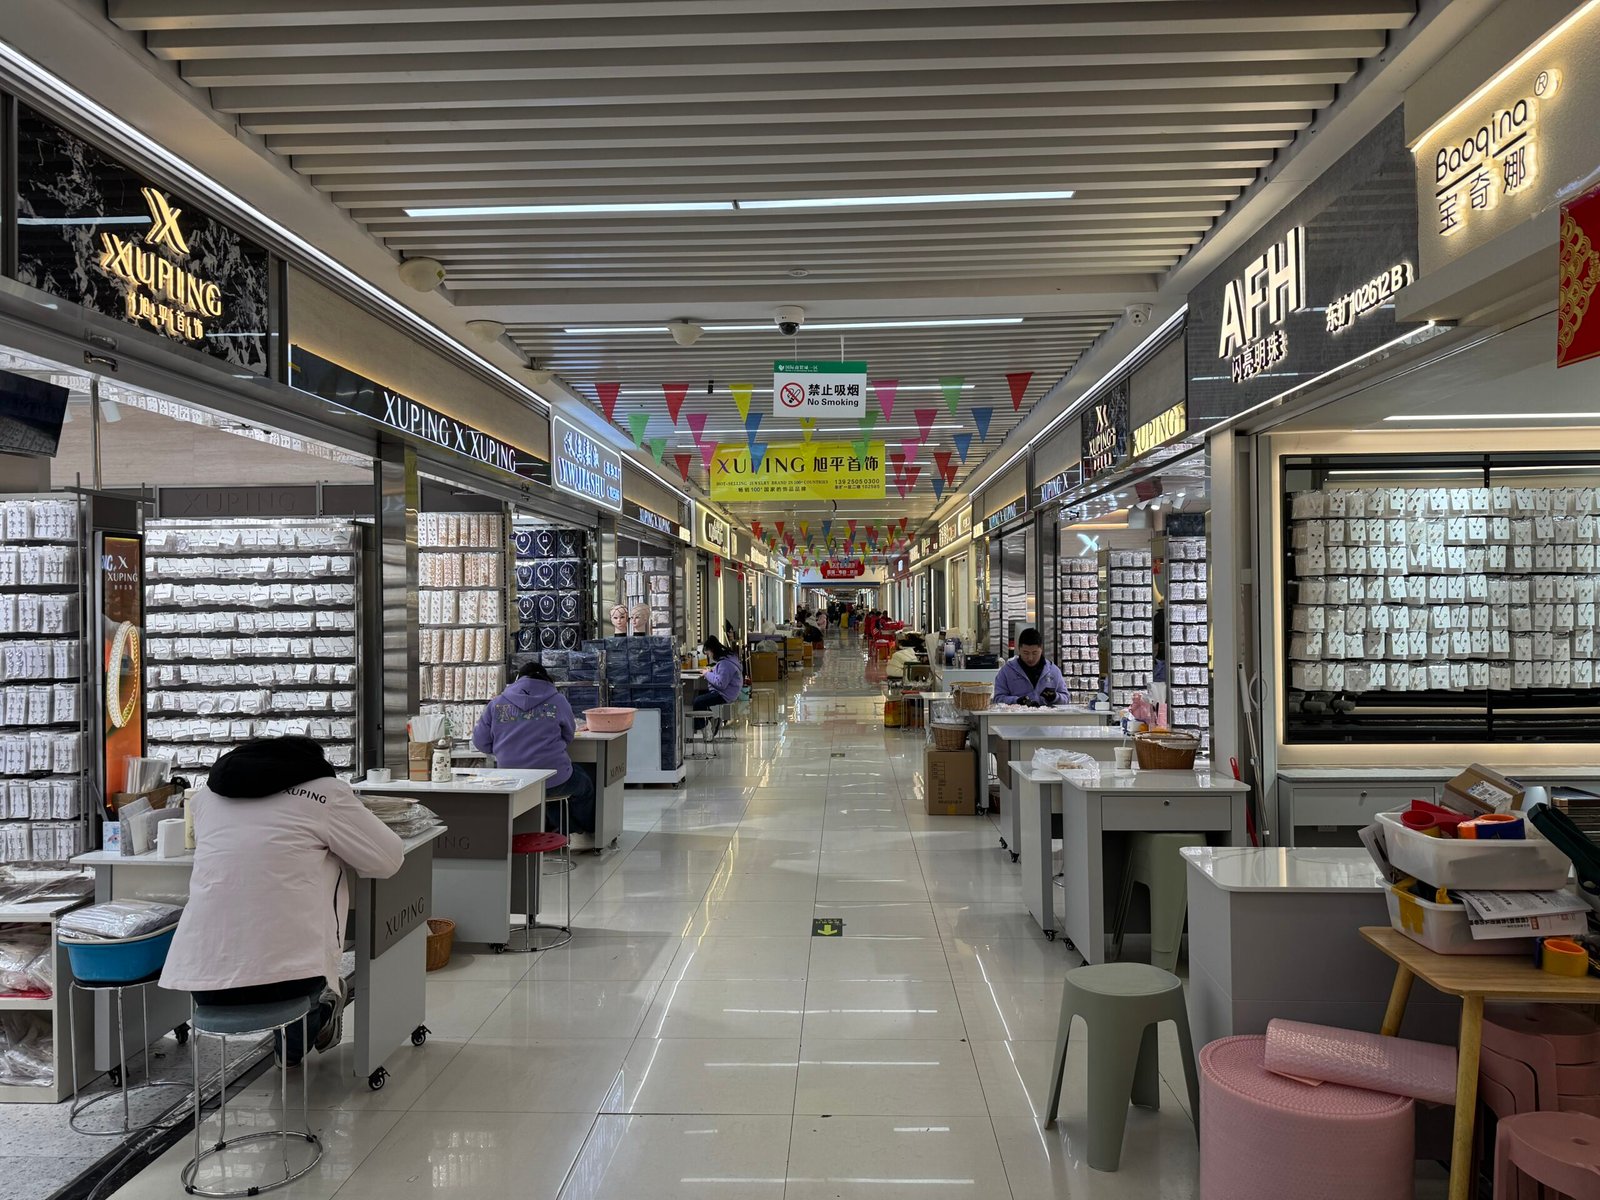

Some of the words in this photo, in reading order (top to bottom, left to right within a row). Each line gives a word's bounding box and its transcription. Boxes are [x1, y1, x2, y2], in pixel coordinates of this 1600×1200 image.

[1435, 99, 1528, 184] Baoqina
[1437, 146, 1528, 236] 宝奇娜
[100, 232, 222, 317] XUPING
[1218, 226, 1306, 359] AFH
[127, 291, 204, 340] 旭平首饰
[1231, 330, 1286, 383] 闪亮明珠
[808, 384, 860, 396] 禁止吸烟
[821, 399, 859, 407] Smoking
[383, 391, 449, 446] XUPING
[453, 422, 466, 451] X
[470, 431, 516, 472] XUPING
[716, 457, 805, 474] XUING
[812, 456, 879, 472] 旭平首饰
[107, 572, 138, 582] XUPING
[385, 896, 425, 939] XUPING
